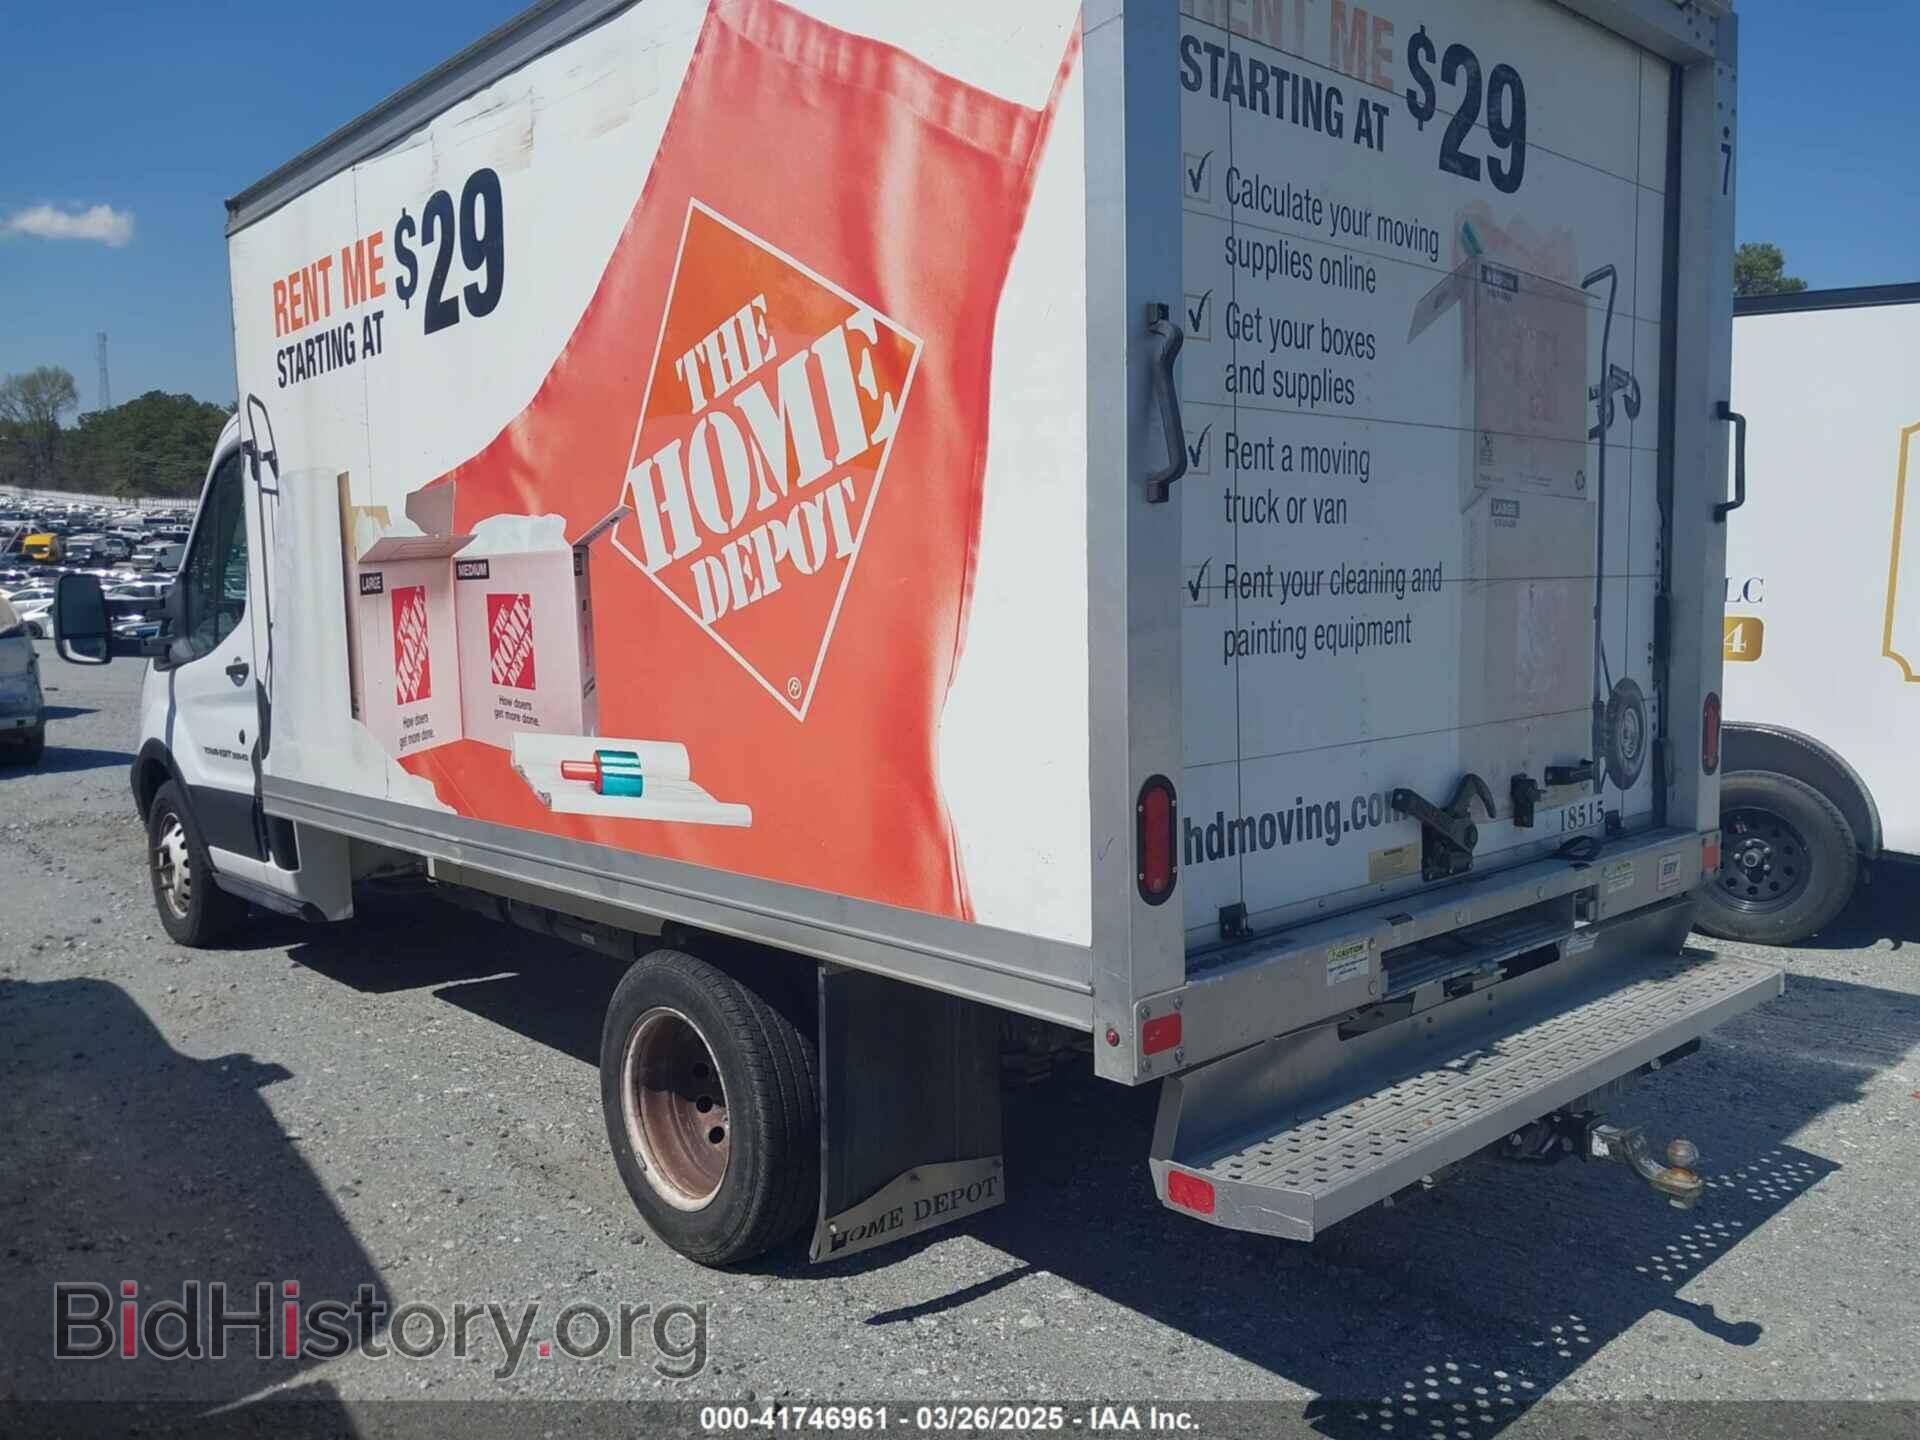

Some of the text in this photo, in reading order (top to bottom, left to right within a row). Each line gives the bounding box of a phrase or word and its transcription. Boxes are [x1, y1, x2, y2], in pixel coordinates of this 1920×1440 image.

[1331, 0, 1393, 90] ME
[1180, 34, 1389, 152] STARTING AT
[1406, 25, 1527, 194] $29
[1225, 166, 1440, 263] Calculate your moving
[273, 230, 386, 338] RENT ME
[394, 168, 504, 336] $29
[1224, 235, 1377, 294] supplies online
[276, 310, 384, 388] STARTING AT
[674, 293, 777, 415] THE
[1225, 301, 1376, 361] Get your boxes
[1224, 361, 1355, 408] and supplies
[627, 308, 898, 576] HOME
[1224, 431, 1370, 485] Rent a moving
[1224, 488, 1347, 525] truck or van
[361, 575, 381, 591] LARGE
[457, 562, 488, 576] MEDIUM
[689, 476, 859, 626] DEPOT
[1224, 561, 1442, 605] Rent your cleaning and
[1223, 613, 1412, 665] painting equipment
[499, 696, 512, 707] How
[1560, 800, 1604, 832] 18515
[830, 1176, 997, 1253] HOME DEPOT
